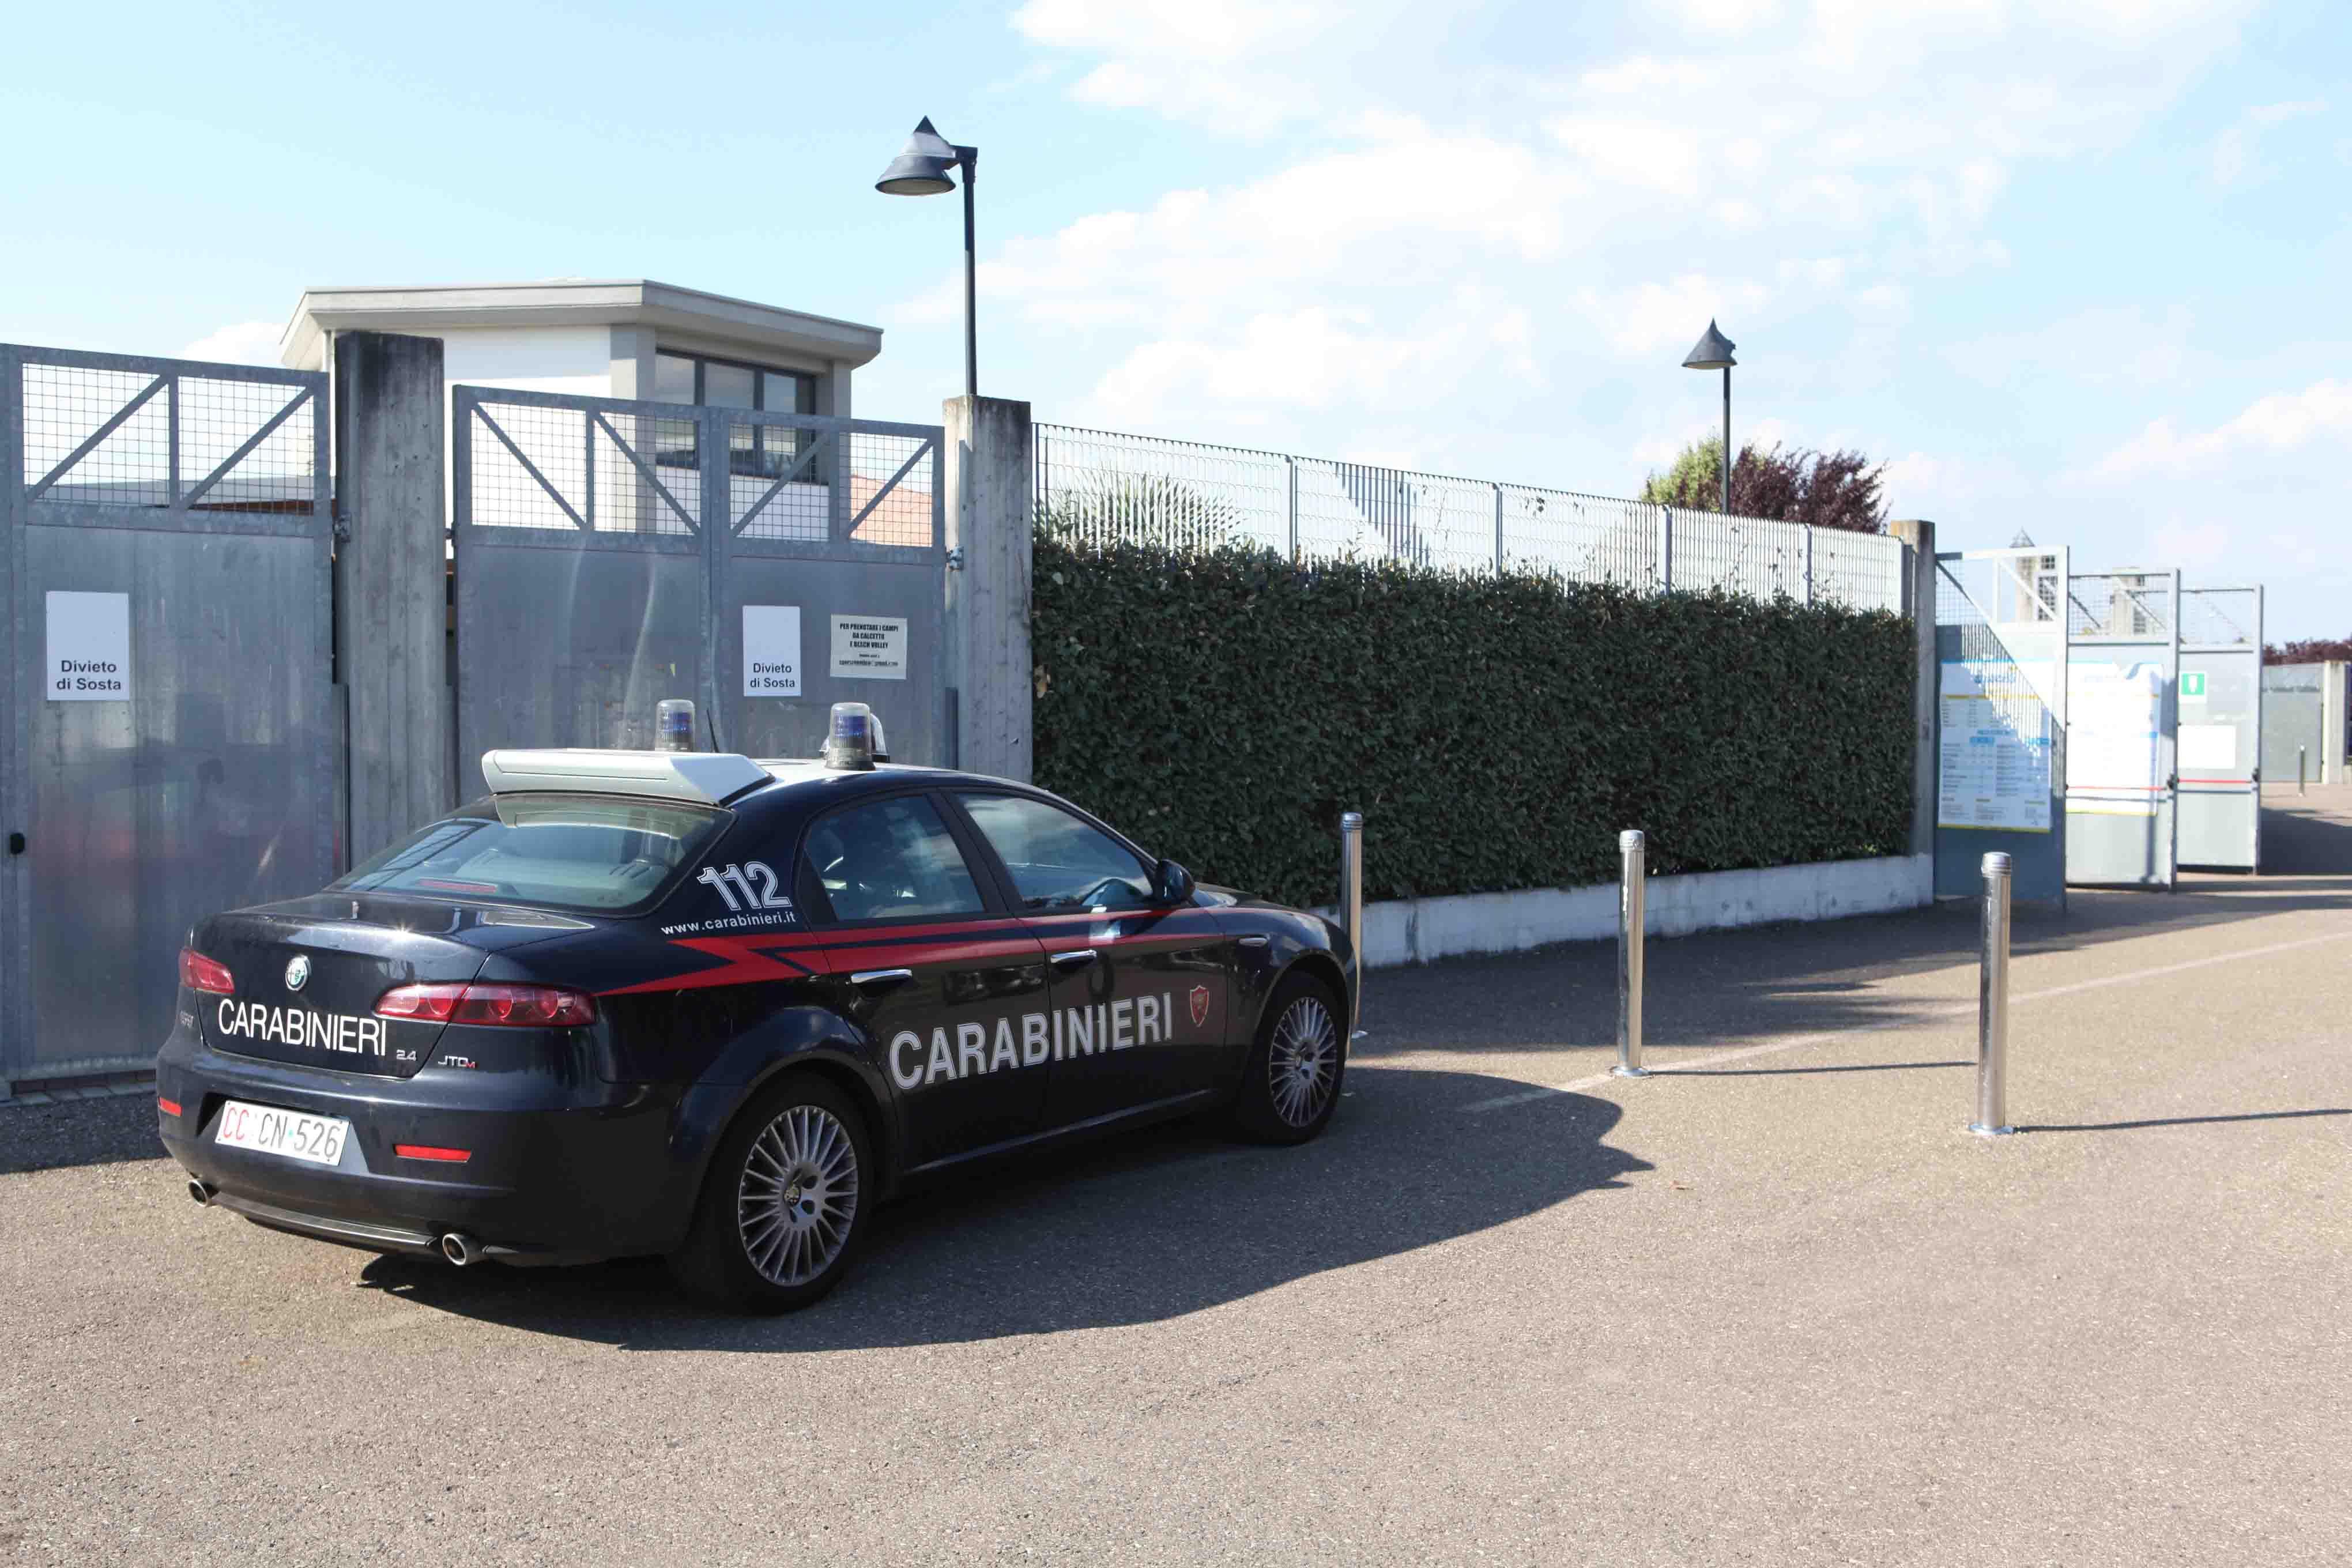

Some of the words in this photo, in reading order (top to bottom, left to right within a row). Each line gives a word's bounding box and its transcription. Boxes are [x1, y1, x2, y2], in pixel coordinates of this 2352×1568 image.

[61, 660, 117, 673] Divieto
[753, 662, 792, 673] Divieto
[56, 678, 70, 690] di
[77, 678, 121, 690] Sosta
[750, 678, 760, 688] di
[764, 678, 795, 688] Sosta
[696, 861, 793, 911] 112
[661, 911, 796, 935] www.carabinieri.it
[218, 998, 386, 1056] CARABINIERI
[889, 992, 1172, 1090] CARABINIERI
[223, 1107, 250, 1140] CC
[258, 1113, 288, 1148] CN
[294, 1119, 340, 1158] 526
